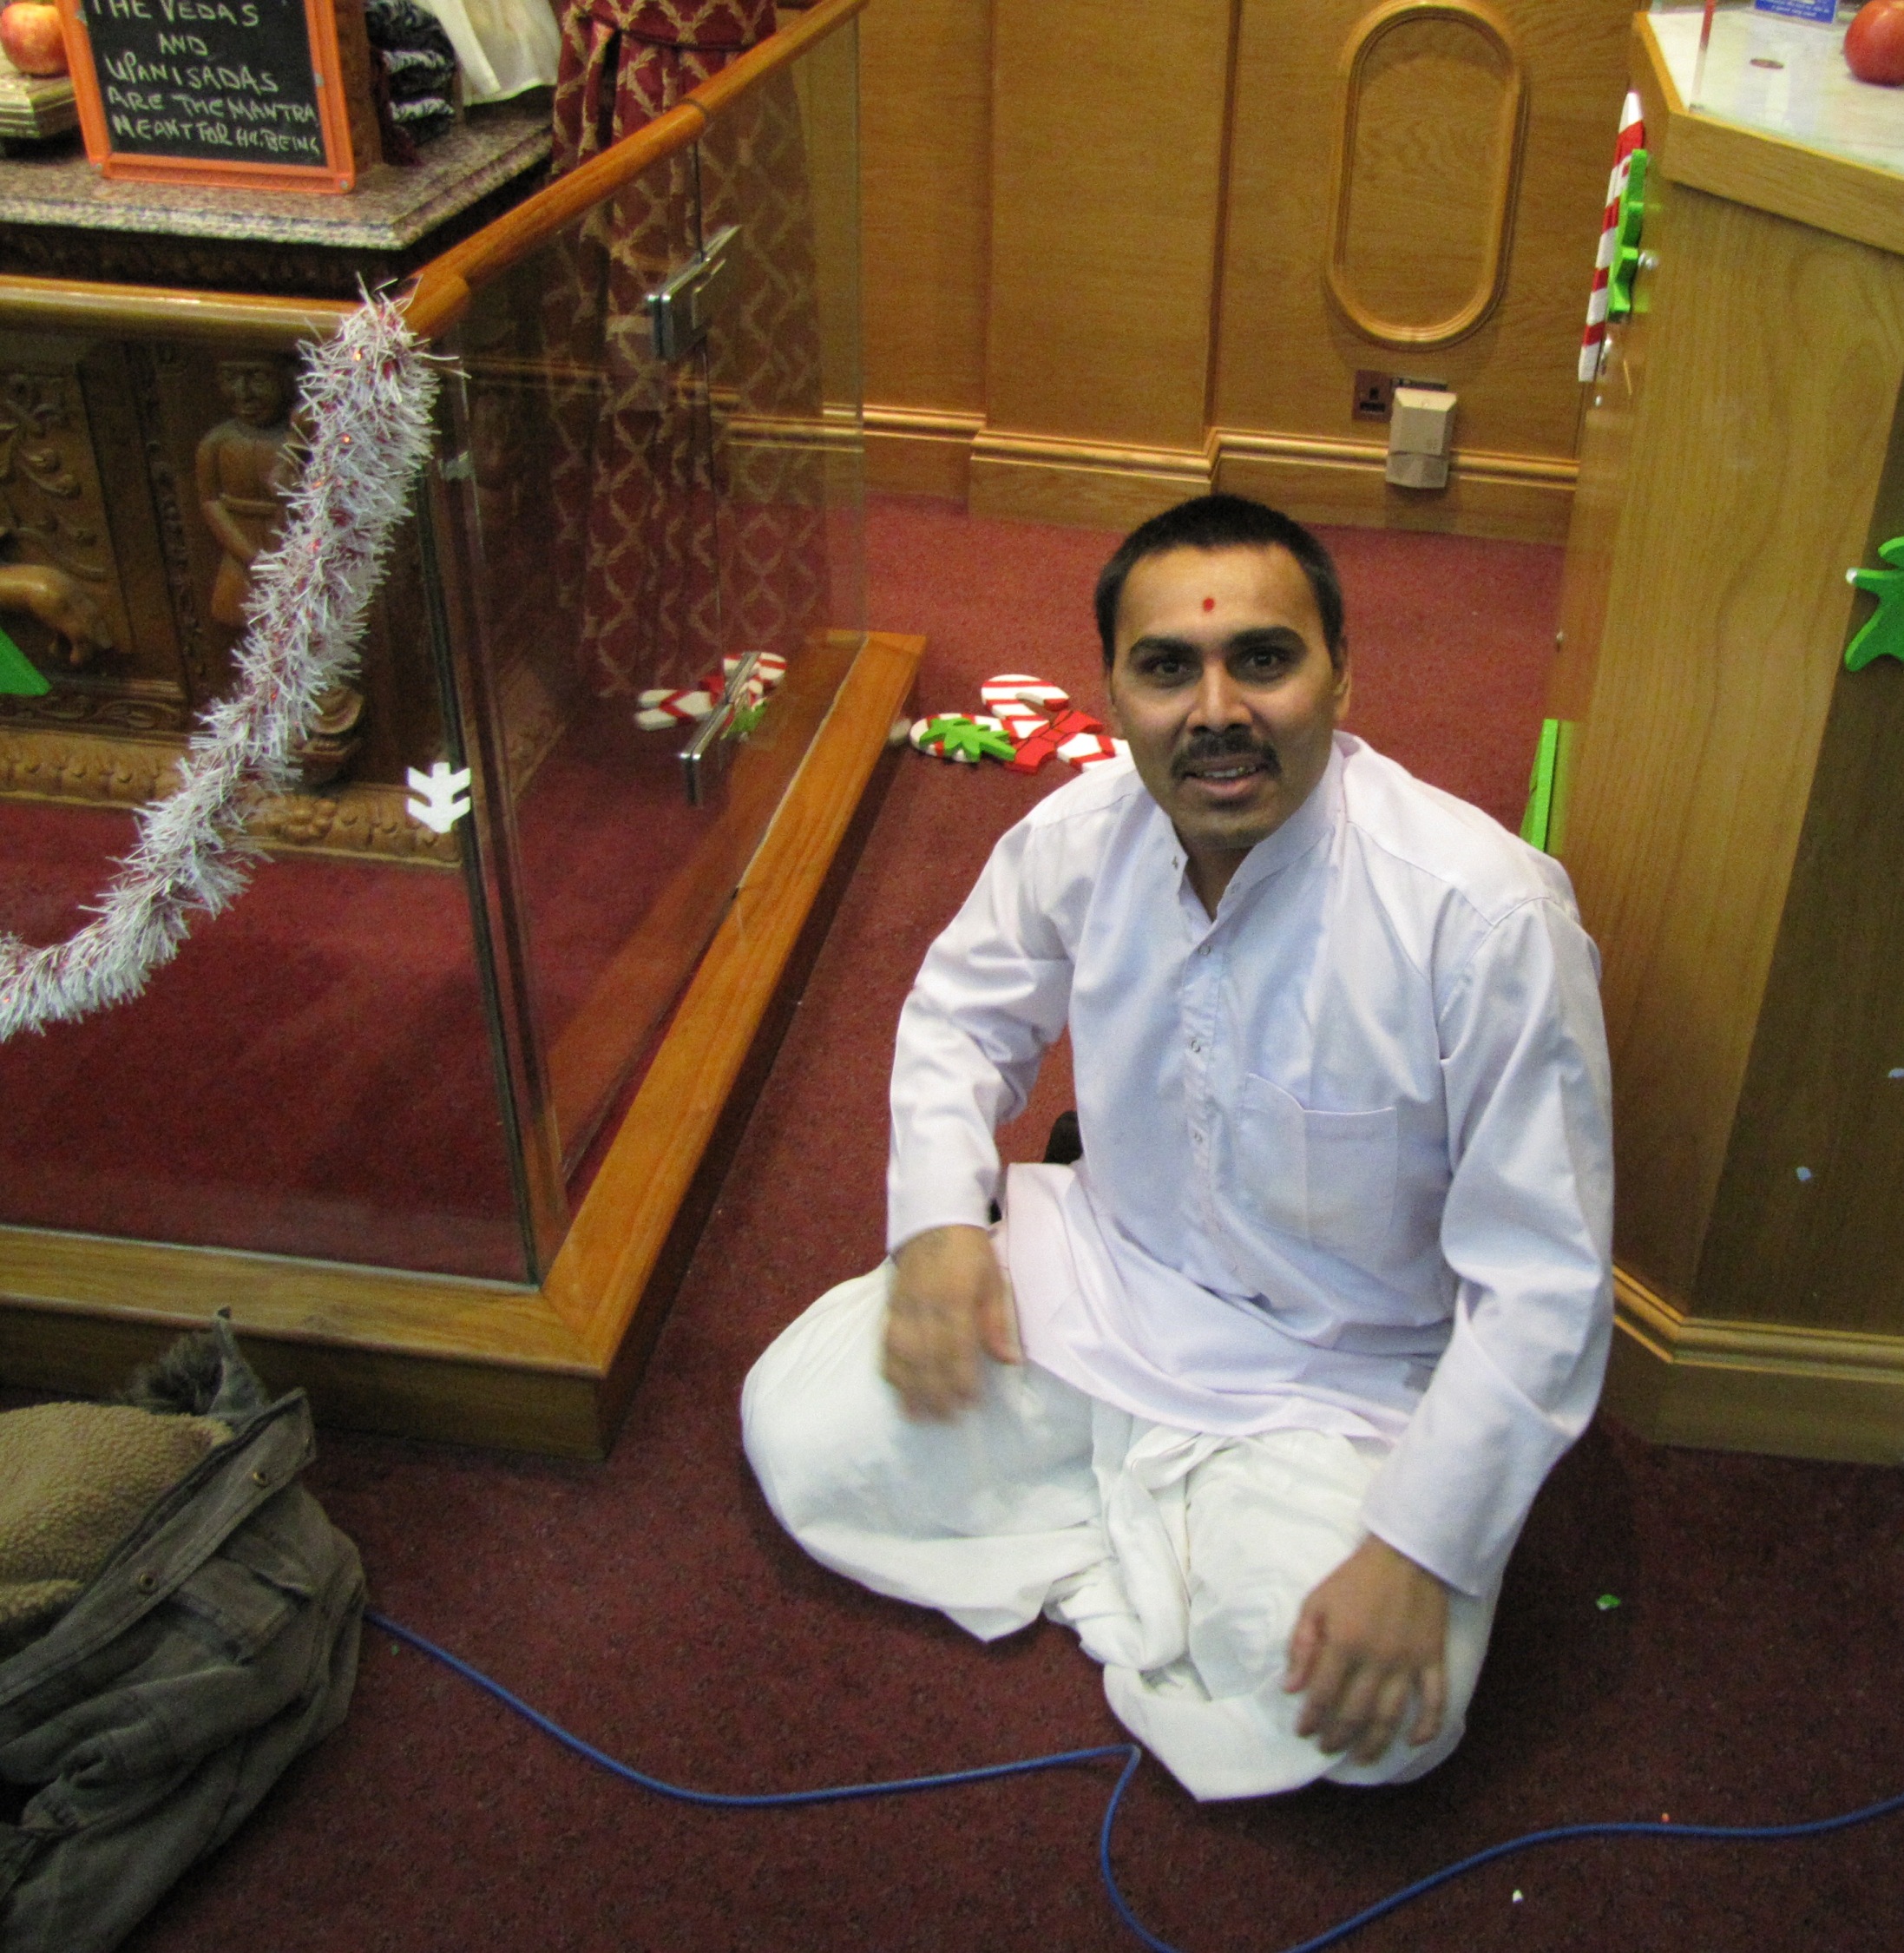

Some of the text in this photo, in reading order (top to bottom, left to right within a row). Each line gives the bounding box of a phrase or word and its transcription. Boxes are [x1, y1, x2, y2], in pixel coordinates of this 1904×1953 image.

[160, 0, 259, 27] VEDAS
[158, 31, 208, 56] AND
[108, 86, 317, 123] ARE THE MANTRA
[112, 115, 194, 141] MEANT
